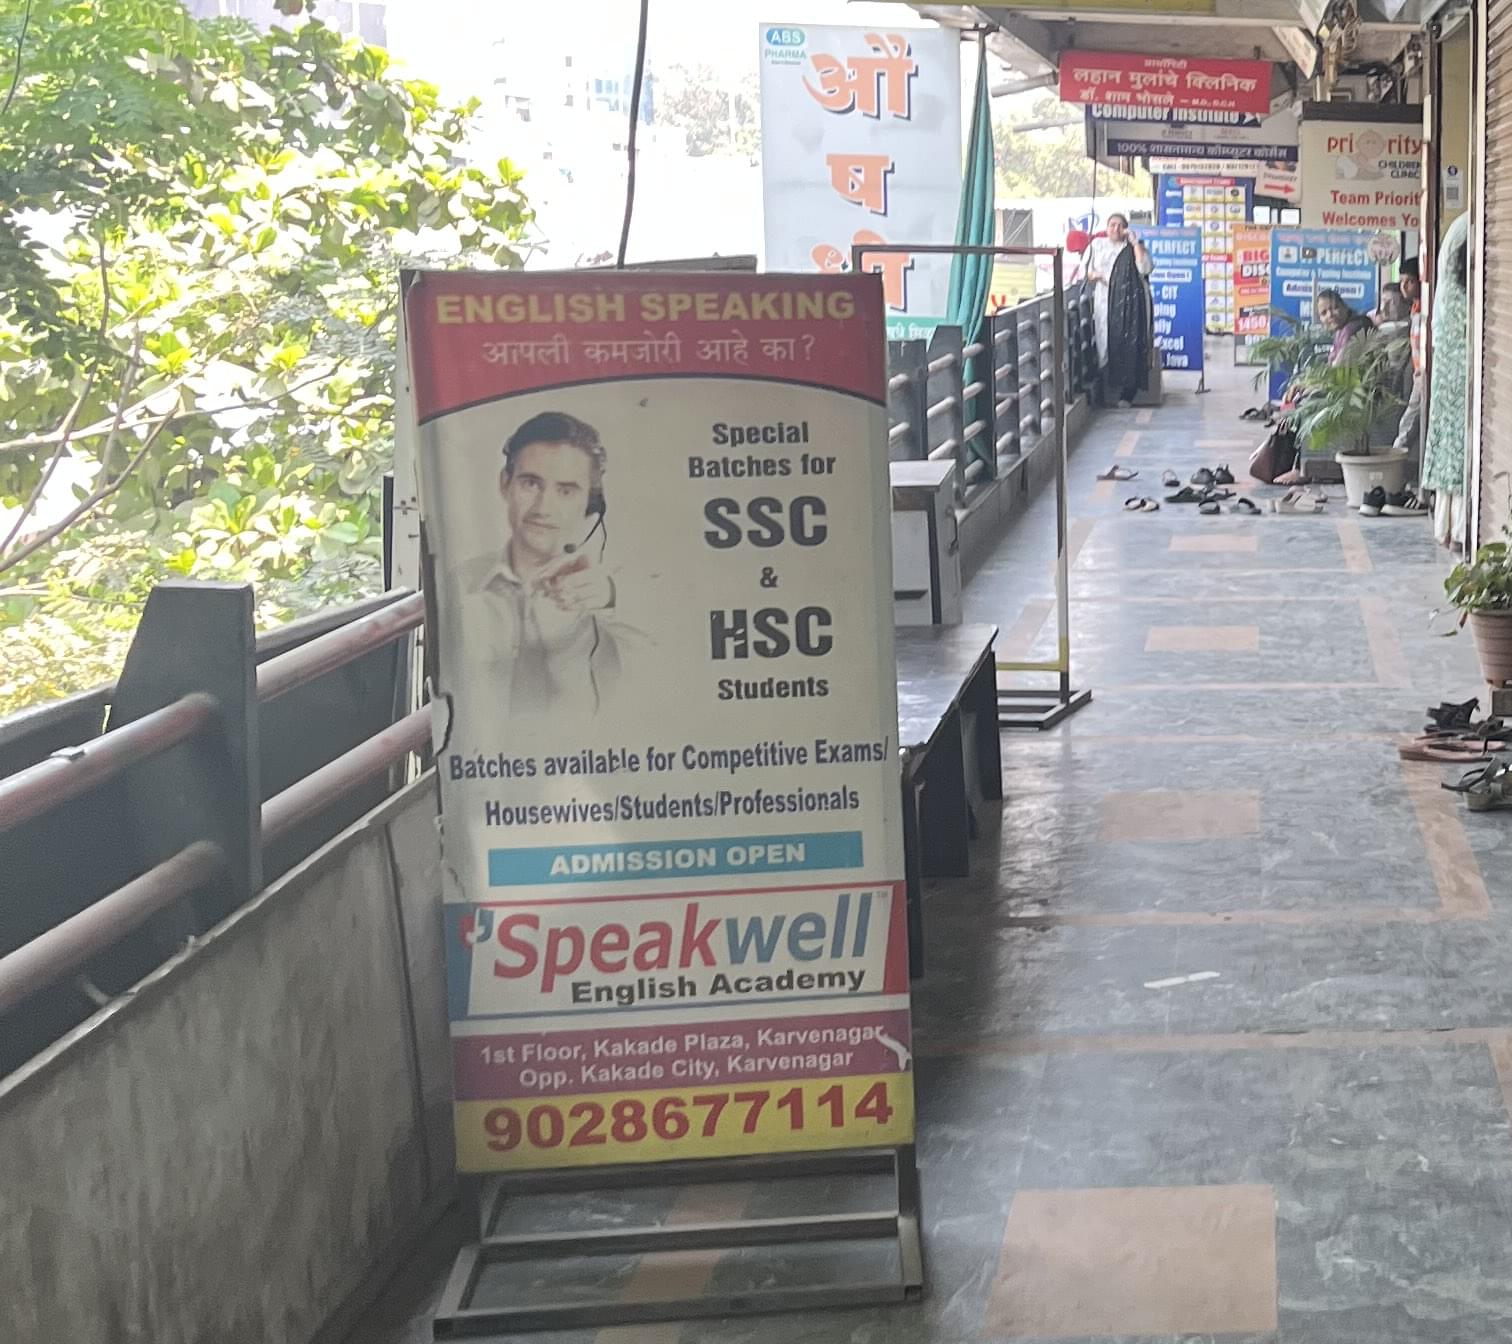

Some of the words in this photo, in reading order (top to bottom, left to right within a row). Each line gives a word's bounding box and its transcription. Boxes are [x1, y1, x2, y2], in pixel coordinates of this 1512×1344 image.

[770, 29, 801, 44] ABS
[1072, 67, 1122, 85] लहान
[1092, 105, 1169, 122] Computer
[1172, 108, 1240, 124] Institute
[1117, 142, 1148, 154] 100%
[1330, 190, 1370, 206] Team
[1375, 190, 1421, 206] Priorit
[1322, 211, 1396, 227] Welcomes
[1401, 213, 1419, 228] Yo
[437, 294, 625, 325] ENGLISH
[641, 291, 856, 322] SPEAKING
[482, 333, 570, 366] आपली
[585, 331, 682, 364] कमजोरी
[698, 329, 748, 365] आहे
[712, 422, 808, 447] Special
[688, 455, 791, 478] Batches
[801, 452, 836, 475] for
[704, 495, 828, 549] SSC
[759, 566, 779, 588] &
[710, 606, 833, 660] HSC
[717, 677, 829, 701] Students
[450, 756, 537, 781] Batches
[544, 747, 641, 777] available
[647, 746, 676, 772] for
[682, 741, 808, 776] Competitive
[549, 849, 717, 876] ADMISSION
[726, 842, 806, 867] OPEN
[493, 892, 873, 994] Speakwell
[571, 975, 696, 1006] English
[709, 968, 867, 997] Academy
[481, 1045, 515, 1065] 1st
[522, 1042, 587, 1065] Floor,
[593, 1035, 677, 1059] Kakade
[685, 1031, 749, 1056] Plaza,
[519, 1068, 573, 1091] Opp.
[581, 1060, 664, 1083] Kakade
[671, 1058, 720, 1081] City,
[727, 1049, 854, 1075] Karvenagar
[483, 1081, 894, 1152] 9028677114
